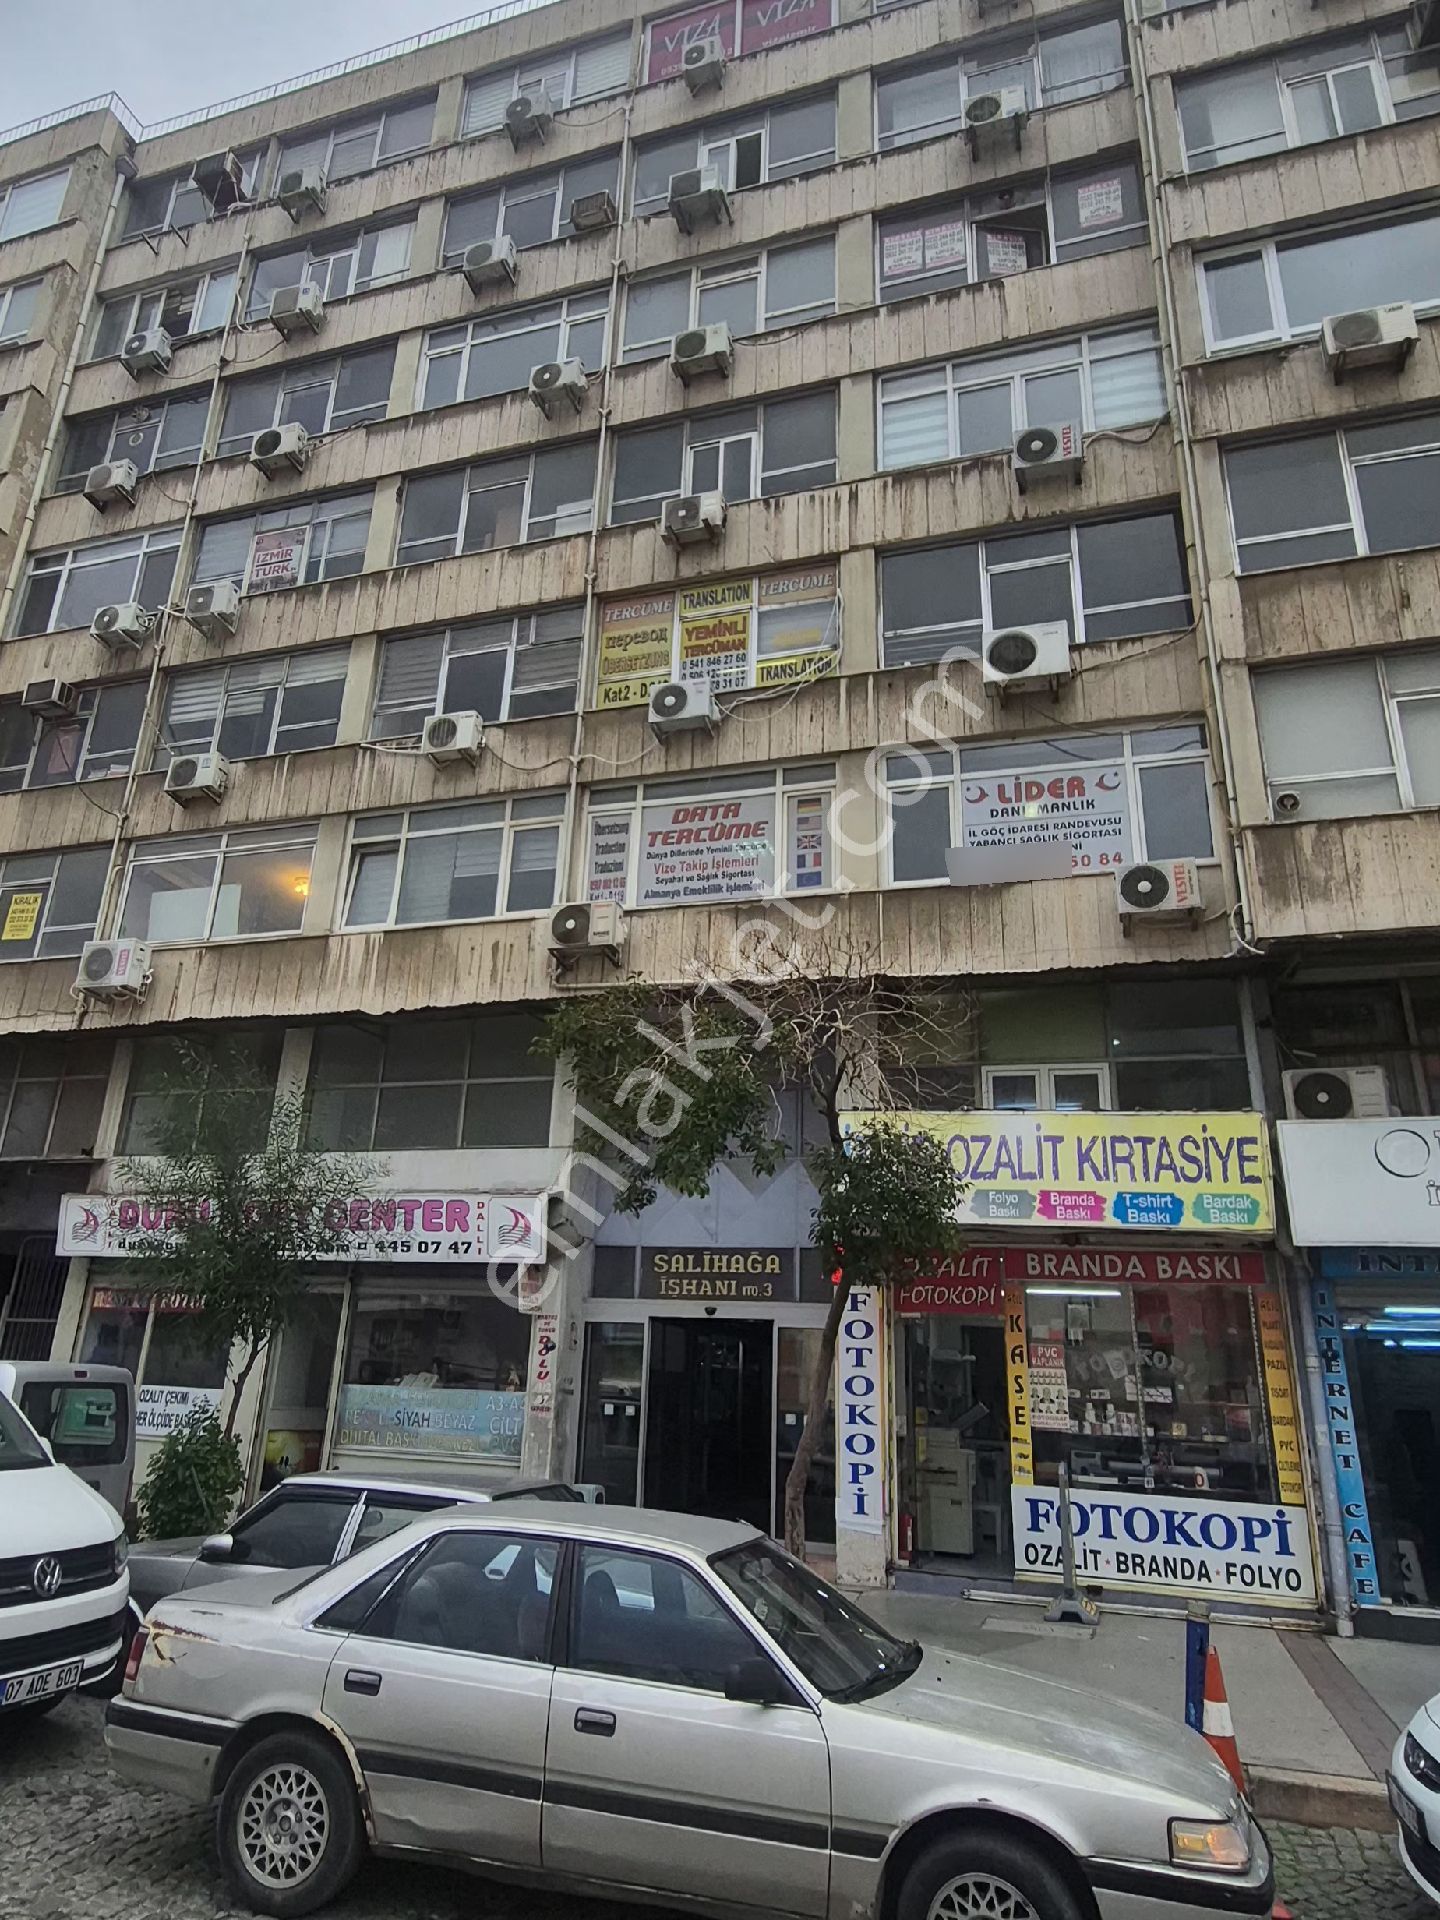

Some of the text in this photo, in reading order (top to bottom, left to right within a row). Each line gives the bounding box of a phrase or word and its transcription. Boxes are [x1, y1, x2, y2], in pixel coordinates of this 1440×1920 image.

[665, 14, 720, 52] VIZA
[683, 583, 750, 610] TRANSLATION
[690, 658, 704, 670] 541
[724, 655, 733, 665] 27
[736, 652, 746, 663] 60
[997, 775, 1086, 804] LİDER
[671, 803, 742, 825] DATA
[647, 821, 769, 847] TERCÜME
[981, 827, 1004, 838] GÖÇ
[1053, 816, 1122, 831] RANDEVUSU
[1019, 833, 1059, 844] SAĞLIK
[654, 855, 759, 875] Vize Takip İşlemleri
[1099, 851, 1123, 866] 84
[644, 888, 681, 901] Almanya
[946, 1123, 1062, 1180] OZALİT
[1077, 1123, 1263, 1184] KIRTASİYE
[988, 1191, 1018, 1204] Folyo
[1050, 1191, 1096, 1207] Branda
[1123, 1194, 1173, 1209] T-shirt
[1202, 1194, 1253, 1211] Bardak
[323, 1198, 470, 1232] CENTER
[989, 1205, 1019, 1217] Baskı
[1055, 1207, 1091, 1220] Baskı
[1127, 1208, 1171, 1224] Baskı
[1208, 1208, 1249, 1225] Baskı
[476, 1201, 485, 1255] DALLI
[375, 1240, 472, 1254] 445 07 47
[653, 1252, 782, 1288] SALİHAĞA
[1026, 1252, 1242, 1280] BRANDA BASKI
[658, 1276, 738, 1298] İŞHANI
[1037, 1346, 1058, 1358] PVC
[844, 1292, 877, 1517] FOTOKOPİ
[394, 1408, 430, 1428] SİYAH
[1279, 1440, 1295, 1451] PVC
[1025, 1498, 1295, 1557] FOTOKOPİ
[1343, 1503, 1375, 1595] CAFE
[1116, 1551, 1212, 1583] BRANDA
[1225, 1562, 1302, 1592] FOLYO
[5, 1680, 24, 1701] 07
[26, 1673, 52, 1696] ADE
